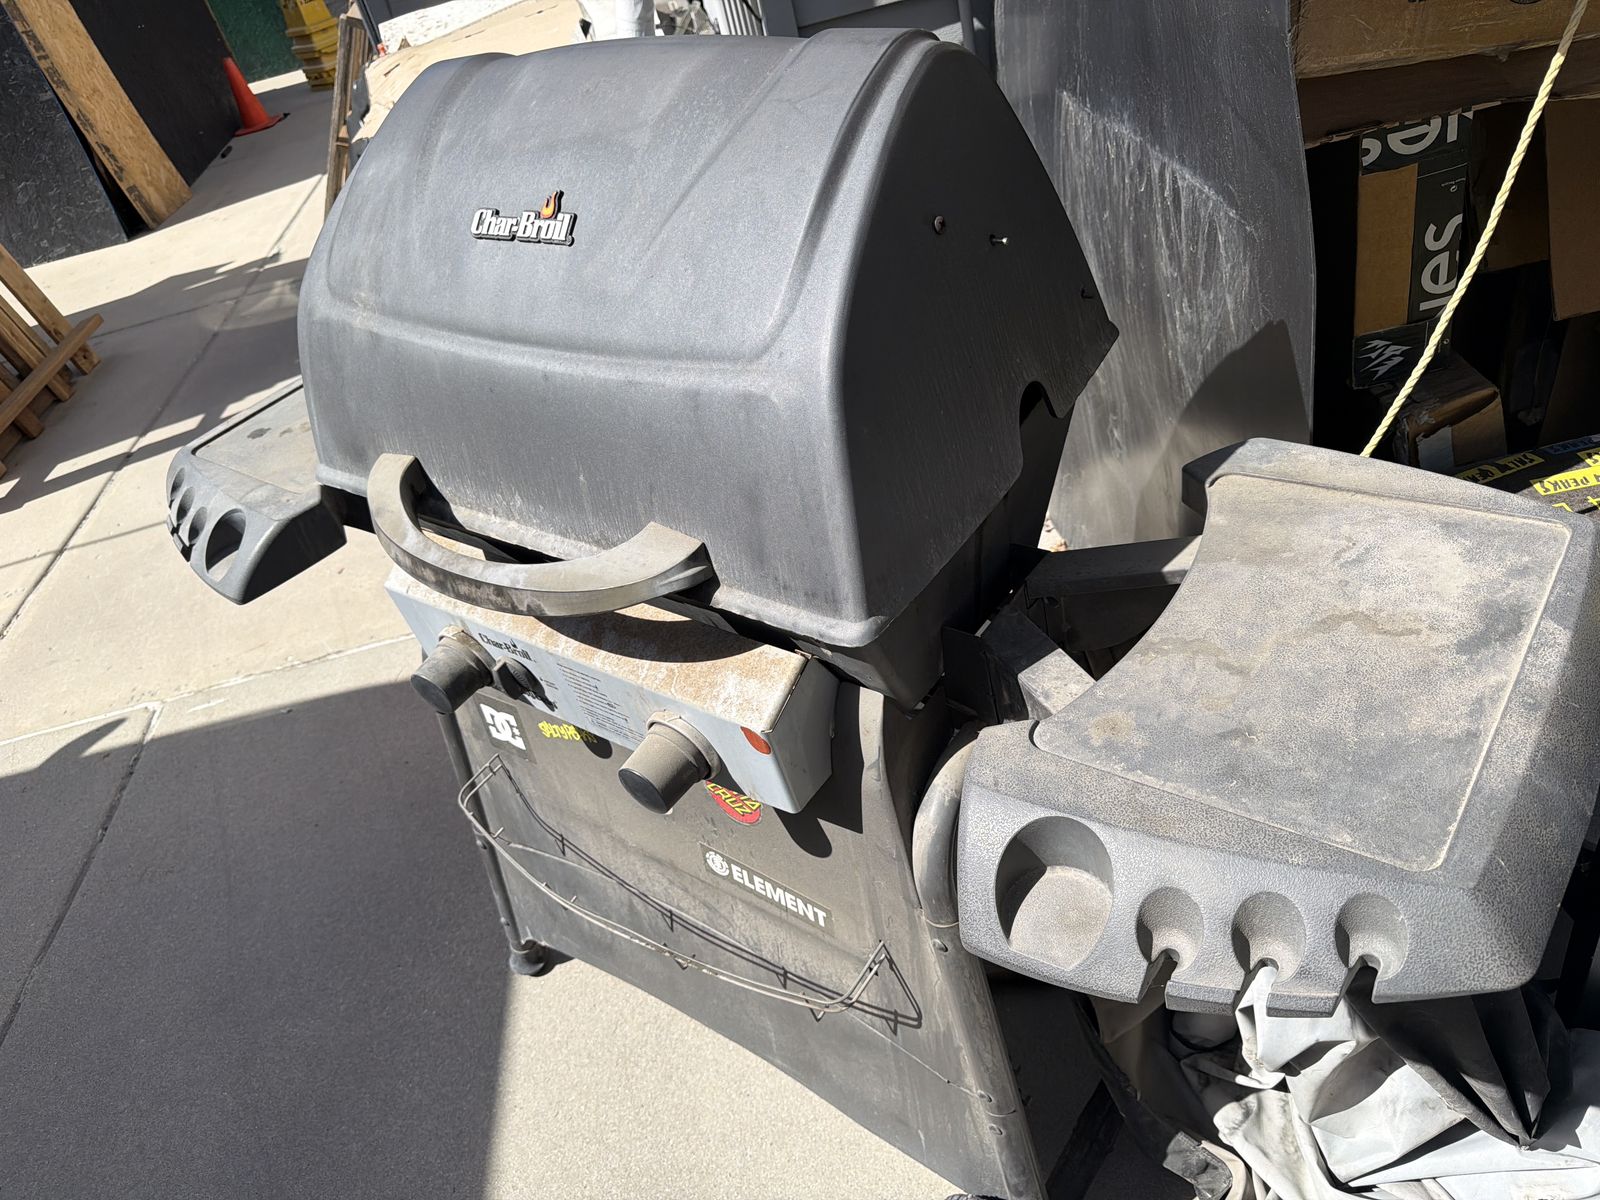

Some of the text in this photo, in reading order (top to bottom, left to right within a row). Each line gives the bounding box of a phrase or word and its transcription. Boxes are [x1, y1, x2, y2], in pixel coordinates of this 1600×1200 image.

[471, 208, 574, 245] Char-Broil
[706, 783, 753, 815] CRUZ
[731, 863, 826, 927] ELEMENT
